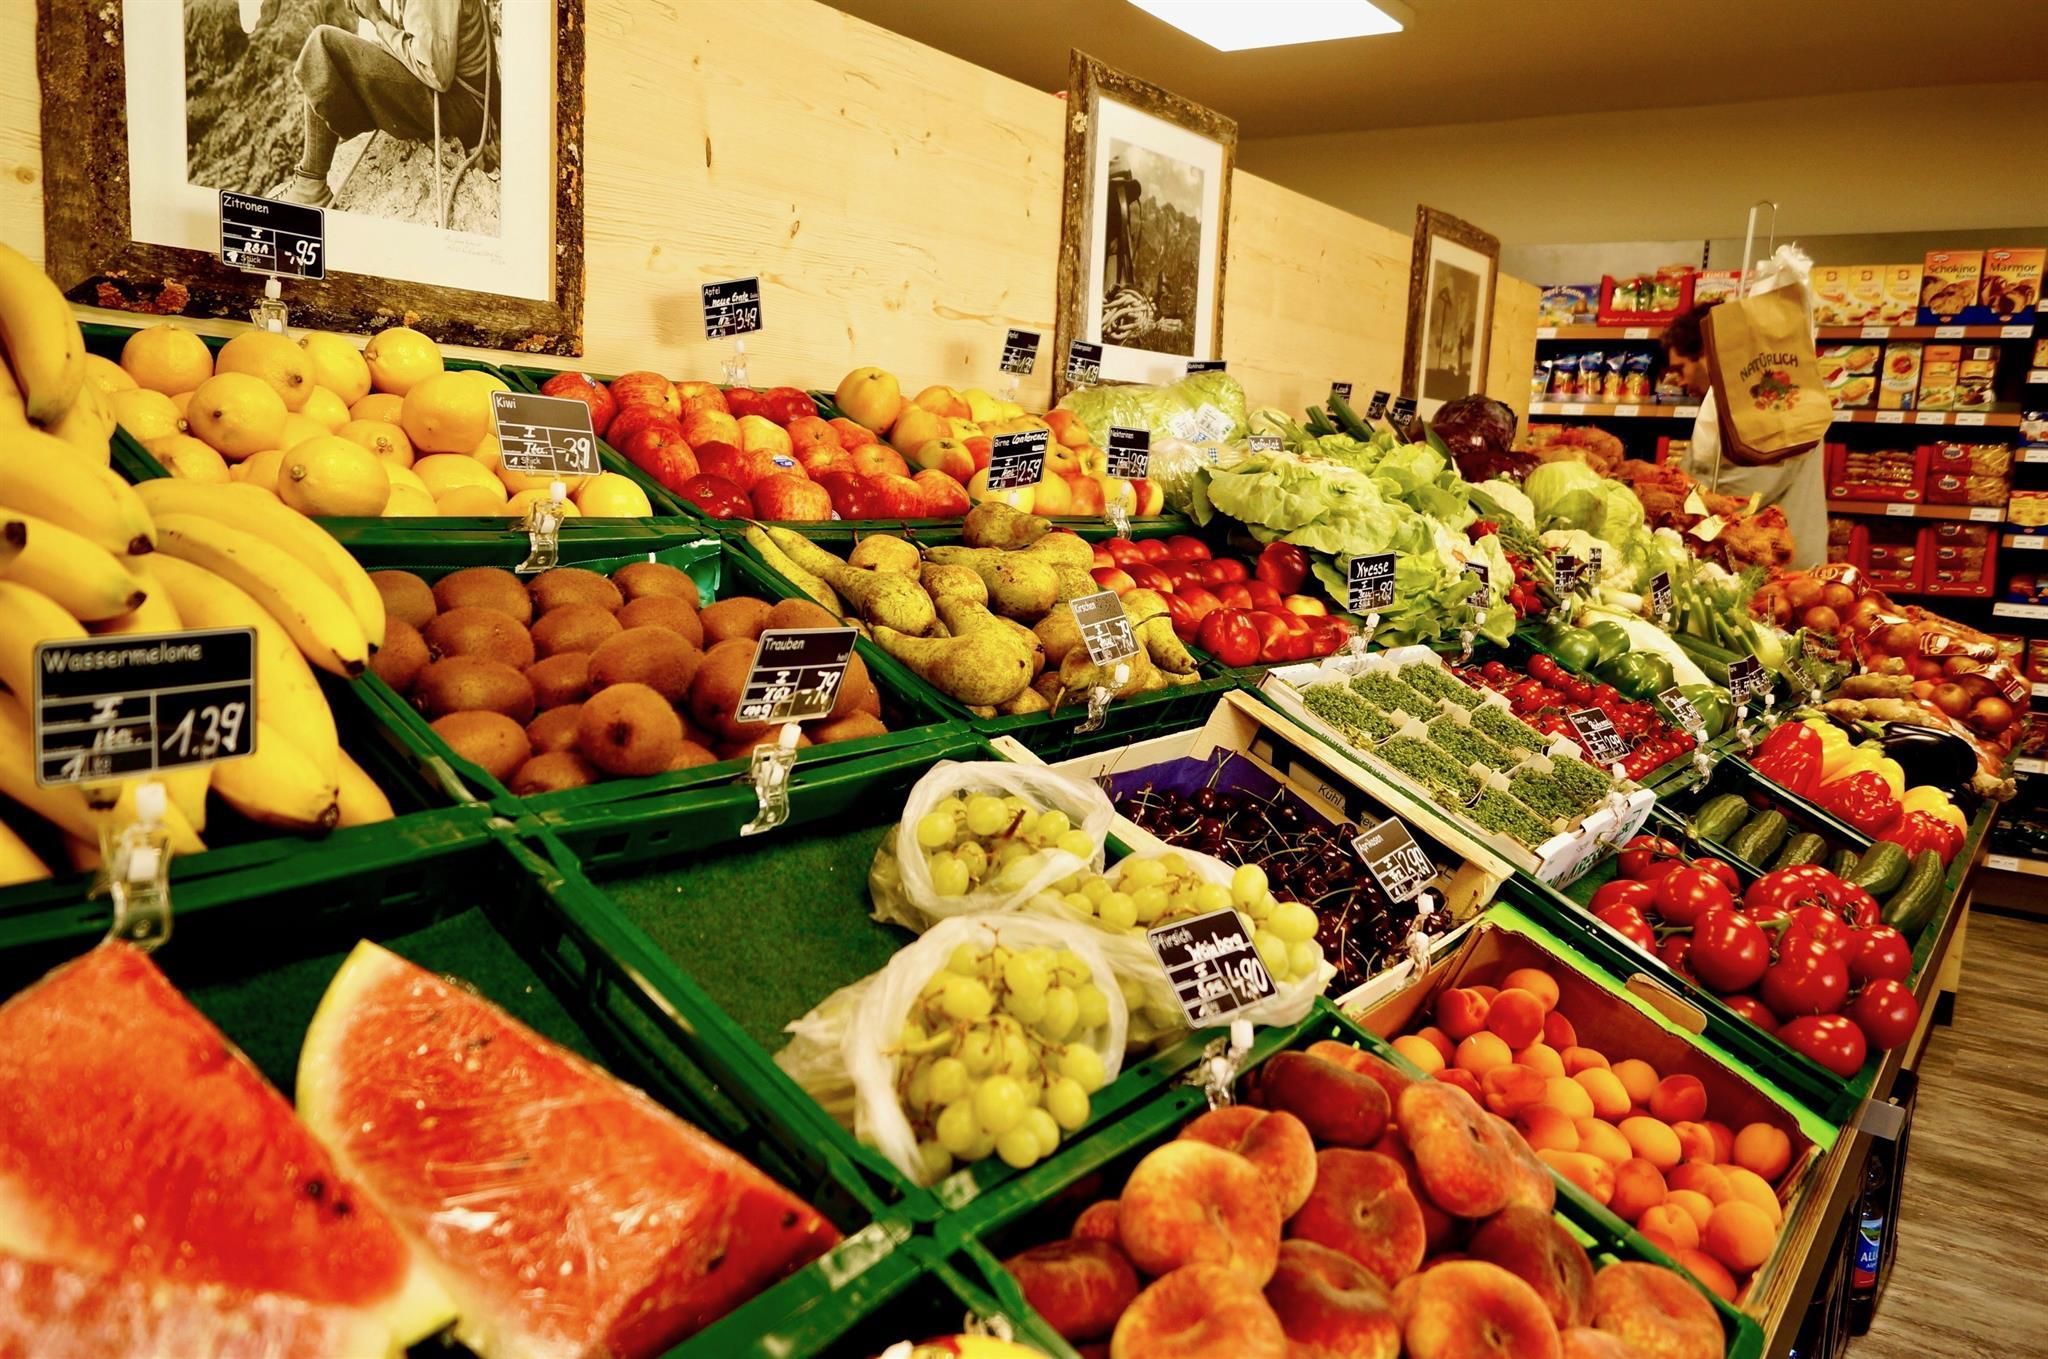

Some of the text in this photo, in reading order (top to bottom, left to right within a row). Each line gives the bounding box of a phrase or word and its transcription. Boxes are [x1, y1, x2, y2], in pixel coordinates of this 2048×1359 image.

[223, 195, 269, 214] Zitronen
[1928, 264, 1977, 273] Schokino
[1990, 263, 2037, 272] Marmor
[705, 286, 720, 297] Apfel
[735, 307, 758, 330] 3.49
[1740, 352, 1799, 382] NATÜRLICH
[496, 397, 517, 409] Kiwi
[1017, 458, 1042, 482] 2.59
[1356, 561, 1389, 578] Kresse
[765, 637, 805, 651] Trauben
[44, 641, 202, 673] Wassermelone
[162, 702, 245, 757] 1.39
[1318, 784, 1342, 806] Kühl
[1151, 927, 1194, 951] Pfirsich
[1224, 957, 1269, 1000] 4.90
